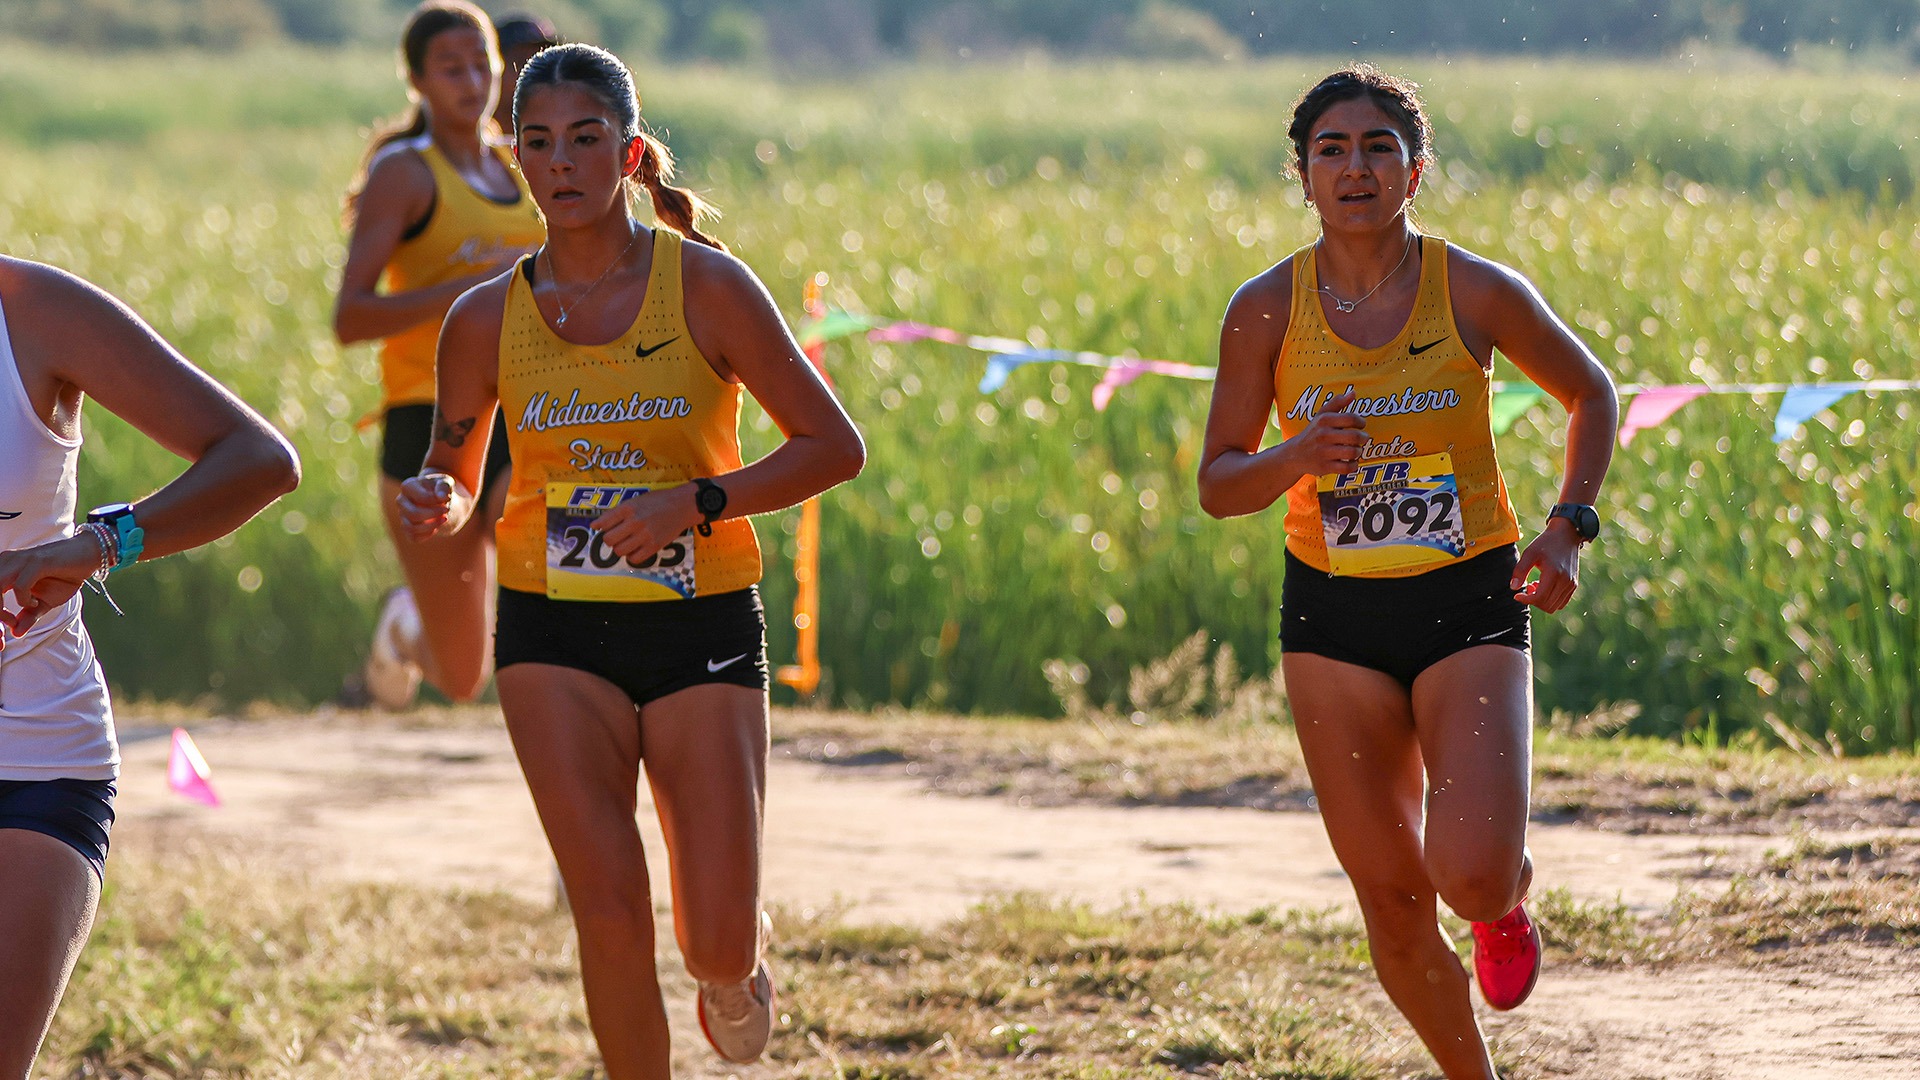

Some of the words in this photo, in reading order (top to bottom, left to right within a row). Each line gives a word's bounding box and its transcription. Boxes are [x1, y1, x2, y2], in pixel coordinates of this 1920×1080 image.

[516, 388, 692, 433] Midwestern
[567, 438, 647, 471] State
[1355, 435, 1417, 462] tate
[1334, 460, 1411, 490] FTR
[1336, 493, 1455, 546] 2092
